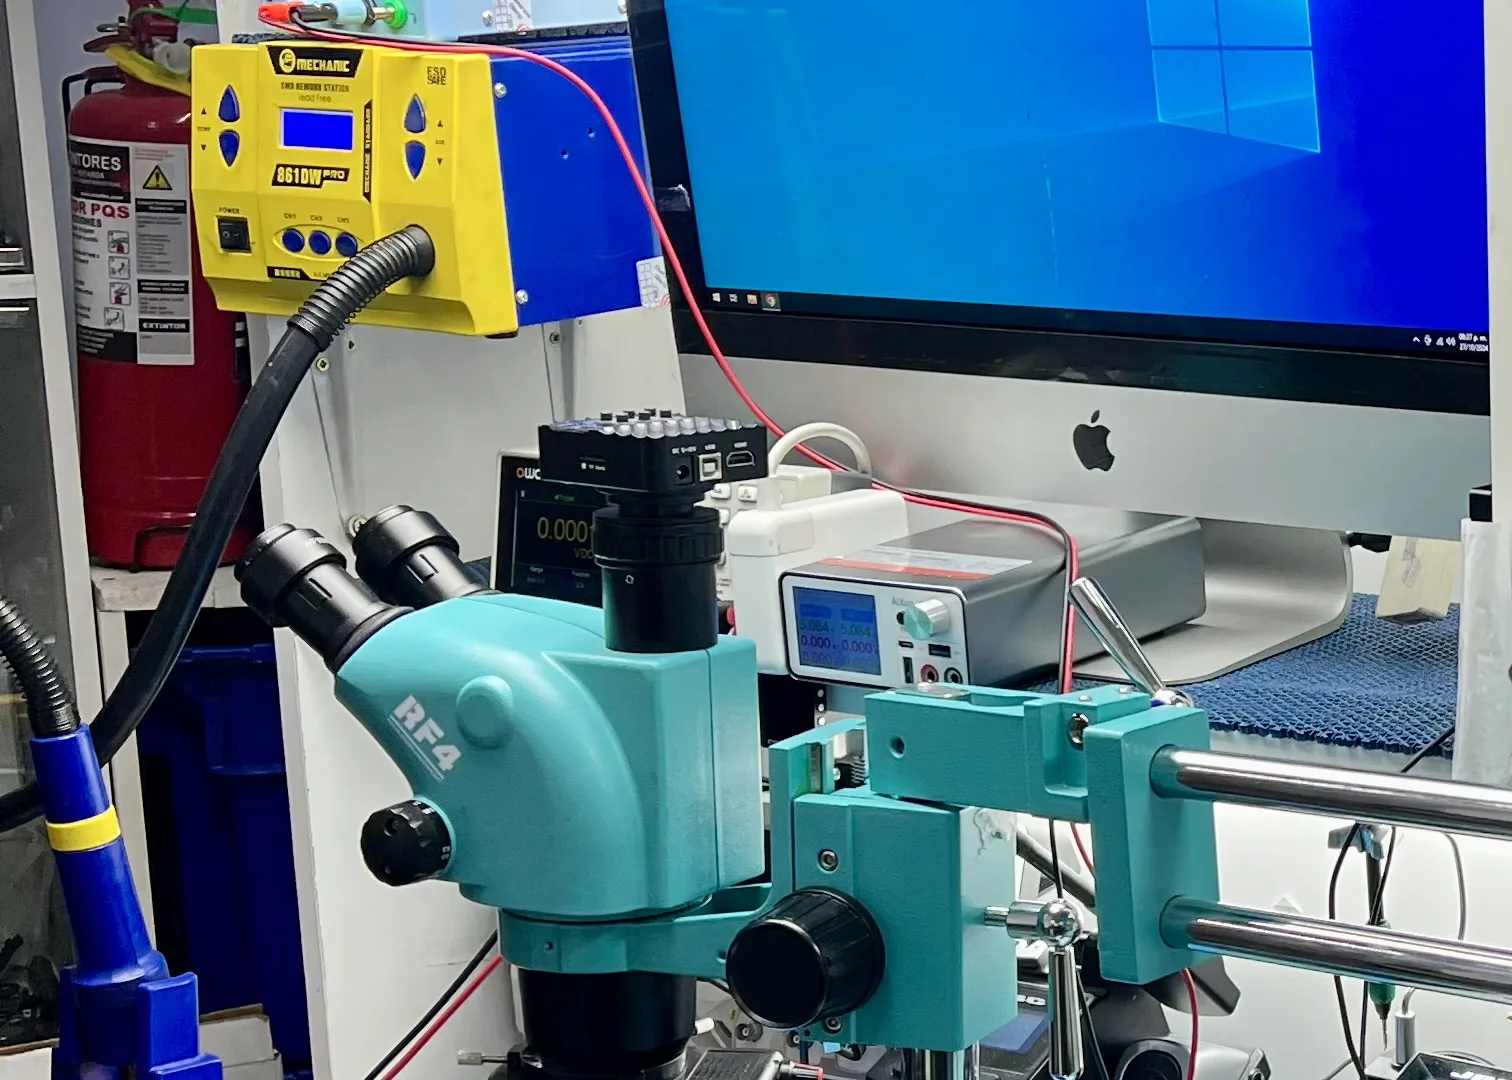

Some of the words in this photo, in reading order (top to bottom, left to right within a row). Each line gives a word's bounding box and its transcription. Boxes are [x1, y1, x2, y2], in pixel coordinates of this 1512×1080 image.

[296, 58, 350, 73] MECHANIC
[426, 66, 447, 77] ESD
[323, 83, 350, 93] STATION
[427, 75, 447, 86] SAFE
[276, 166, 323, 186] 861DW
[322, 170, 346, 181] PRO
[90, 203, 130, 218] PQS
[801, 634, 831, 649] 0.000
[842, 641, 872, 654] 0.000
[392, 694, 462, 771] RF4
